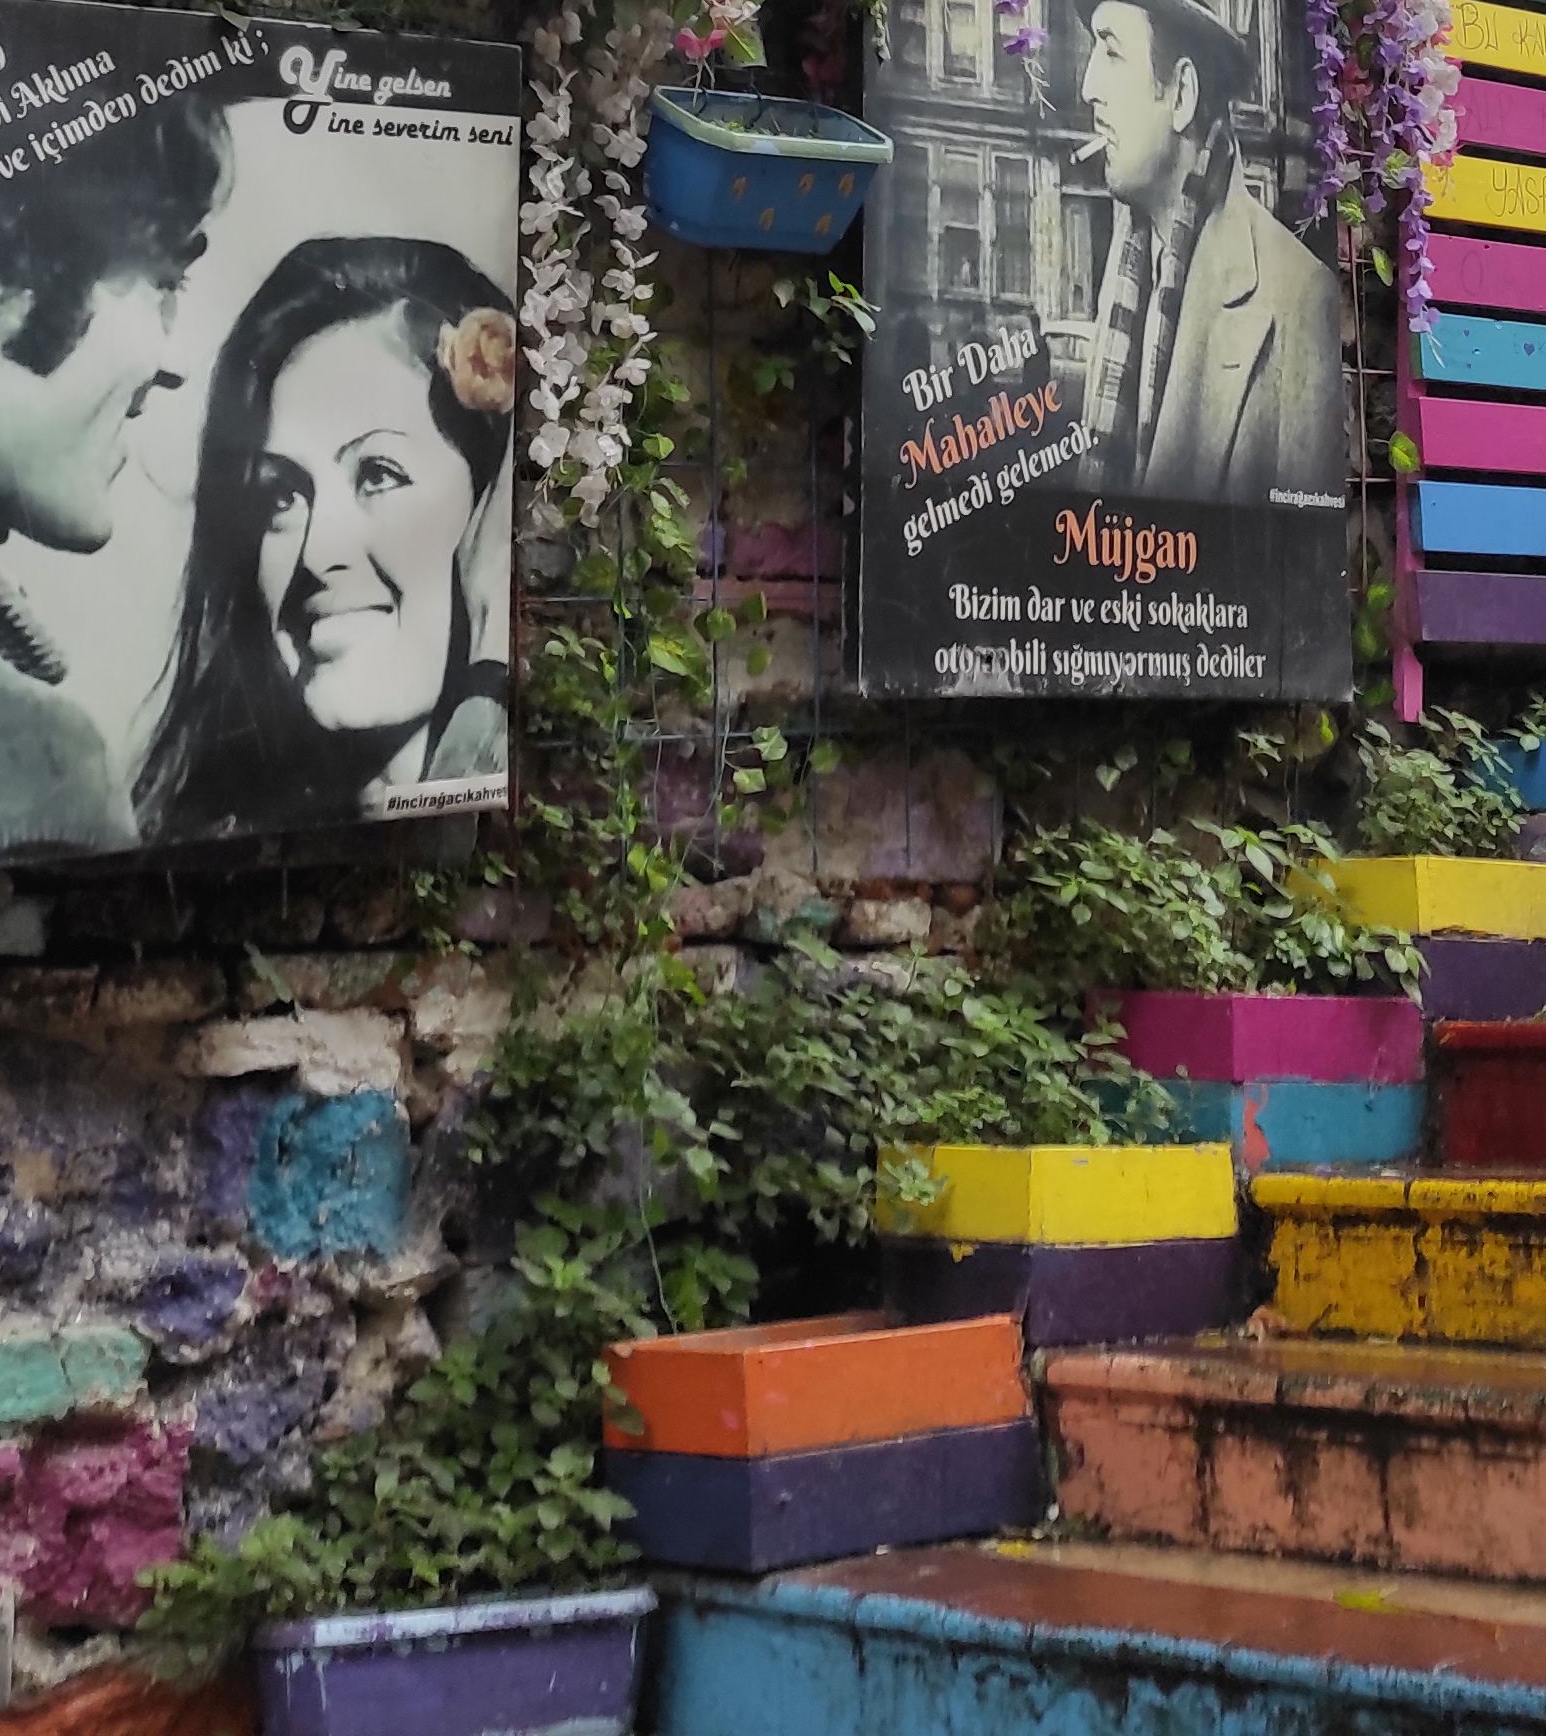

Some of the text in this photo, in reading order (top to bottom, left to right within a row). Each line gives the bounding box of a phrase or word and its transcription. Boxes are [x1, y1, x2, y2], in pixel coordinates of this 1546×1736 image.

[1455, 1, 1500, 52] BU
[27, 90, 139, 167] içimden
[136, 48, 223, 106] dedim
[373, 68, 453, 106] gelsen
[370, 116, 461, 144] severim
[467, 123, 515, 148] seni
[902, 322, 1040, 413] Bir Daha
[899, 378, 1064, 490] Mahalleye
[902, 468, 994, 557] gelmedi
[1053, 497, 1198, 585] Müjgan
[948, 583, 1249, 635] Bizim dar ve eski sokaklara
[1196, 642, 1268, 679] dediler
